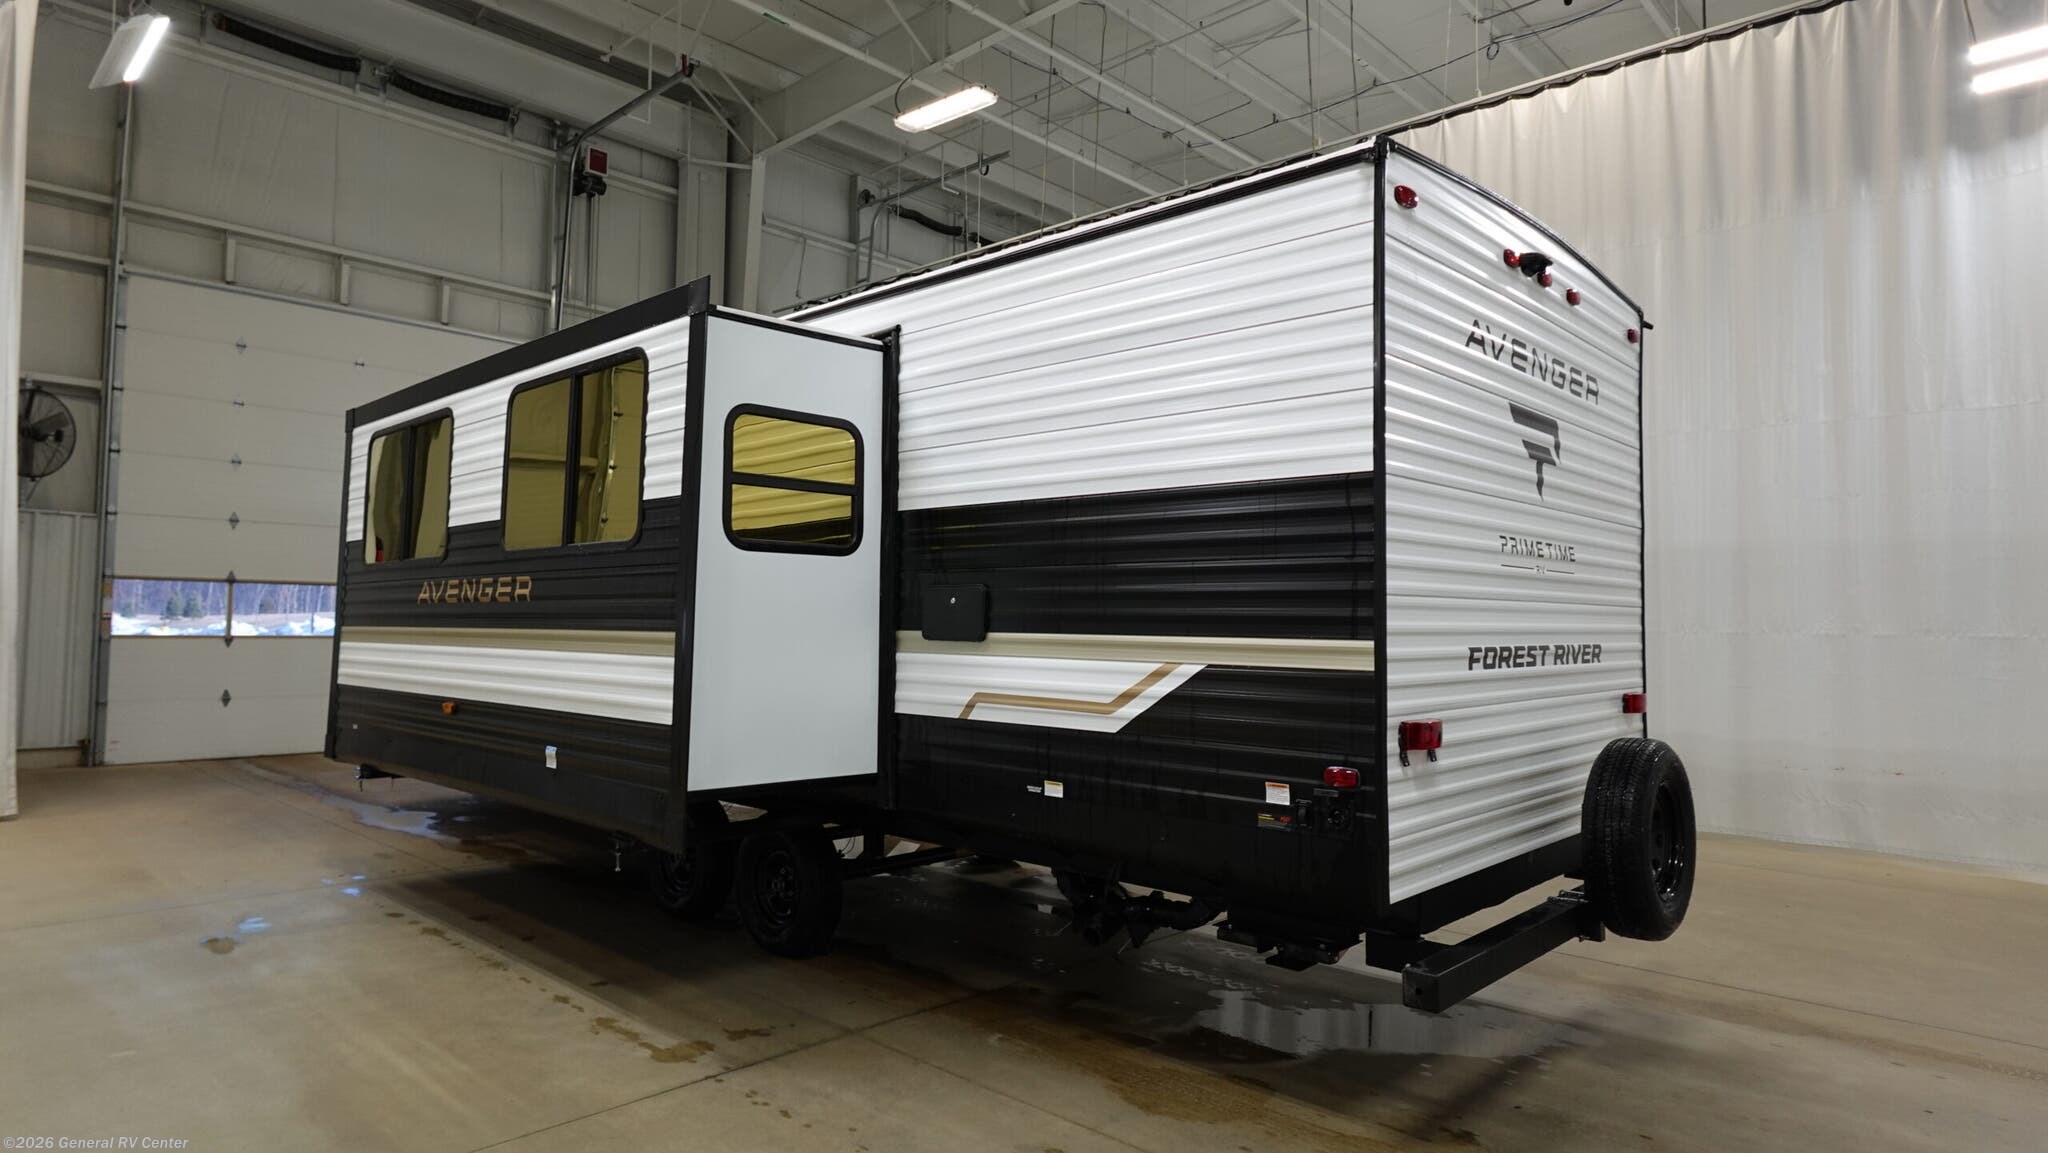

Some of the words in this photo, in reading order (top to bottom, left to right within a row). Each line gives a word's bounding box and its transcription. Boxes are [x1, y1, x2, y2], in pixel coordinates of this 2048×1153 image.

[1465, 319, 1600, 406] AVENGER
[1499, 535, 1576, 562] PRIMETIME
[417, 575, 532, 604] AVENGER
[1467, 645, 1550, 671] FOREST
[1553, 643, 1602, 666] RIVER
